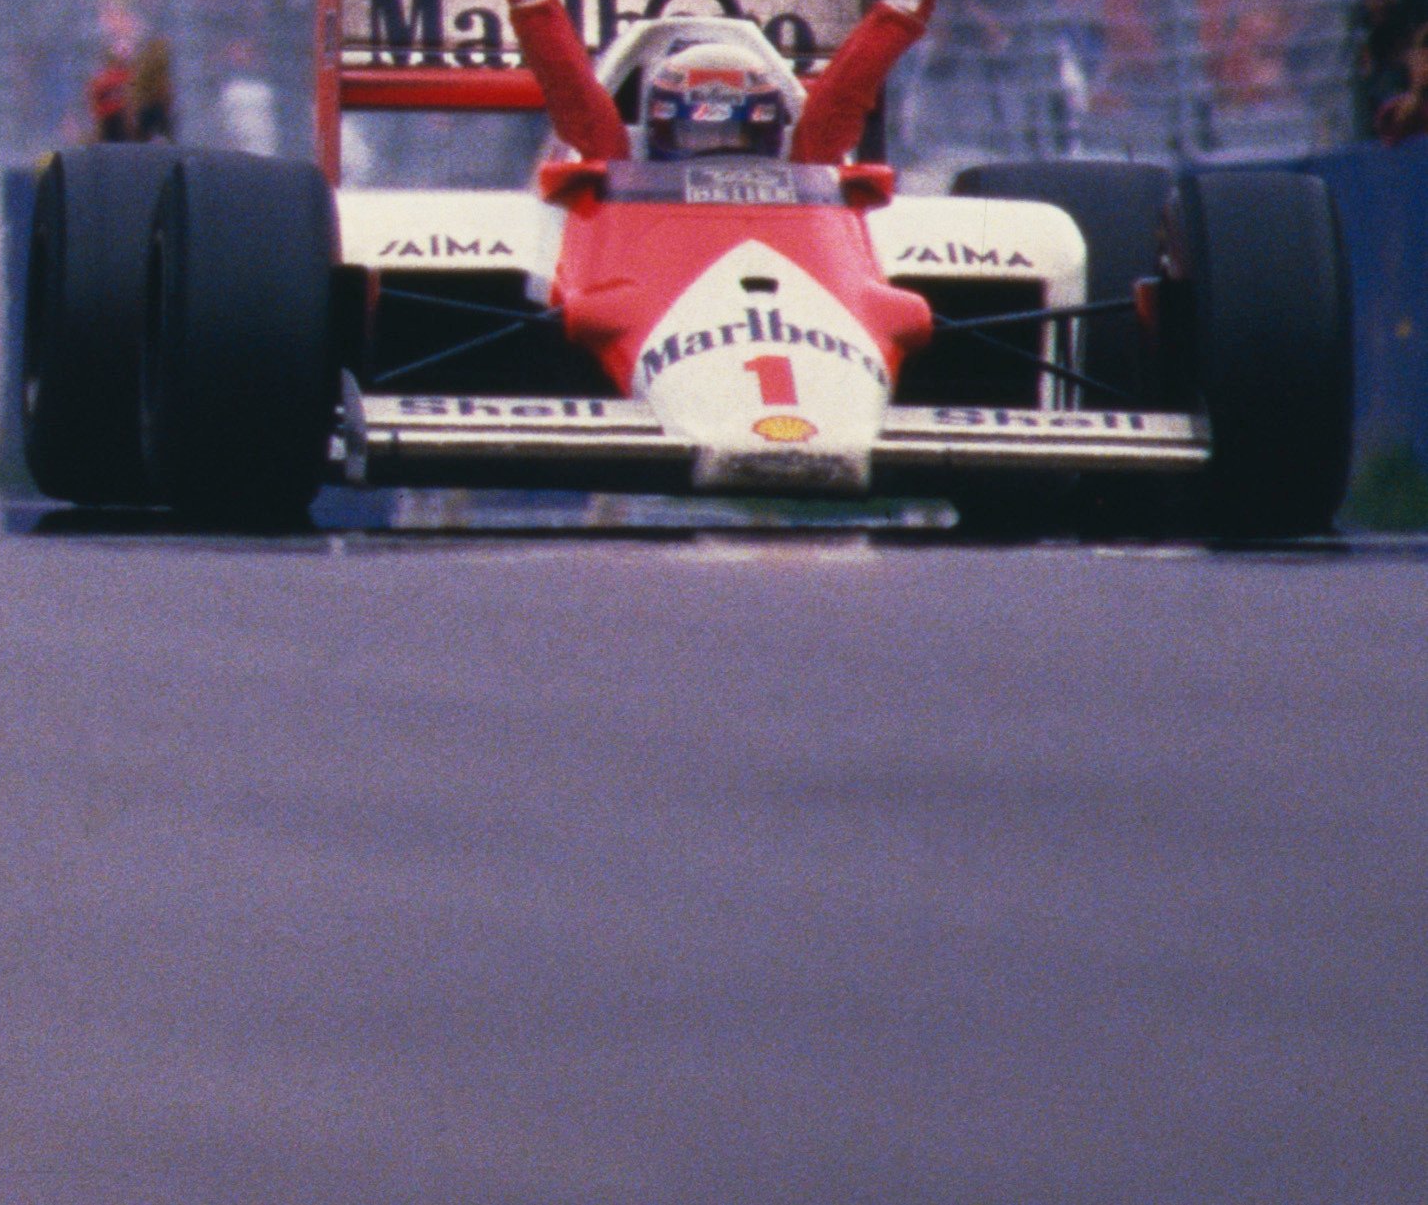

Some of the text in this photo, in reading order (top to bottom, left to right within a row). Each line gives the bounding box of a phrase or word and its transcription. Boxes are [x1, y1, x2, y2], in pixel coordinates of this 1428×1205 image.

[642, 307, 889, 388] Marlboro
[743, 354, 799, 406] 1
[399, 397, 605, 417] Shell
[933, 408, 1144, 431] Shell
